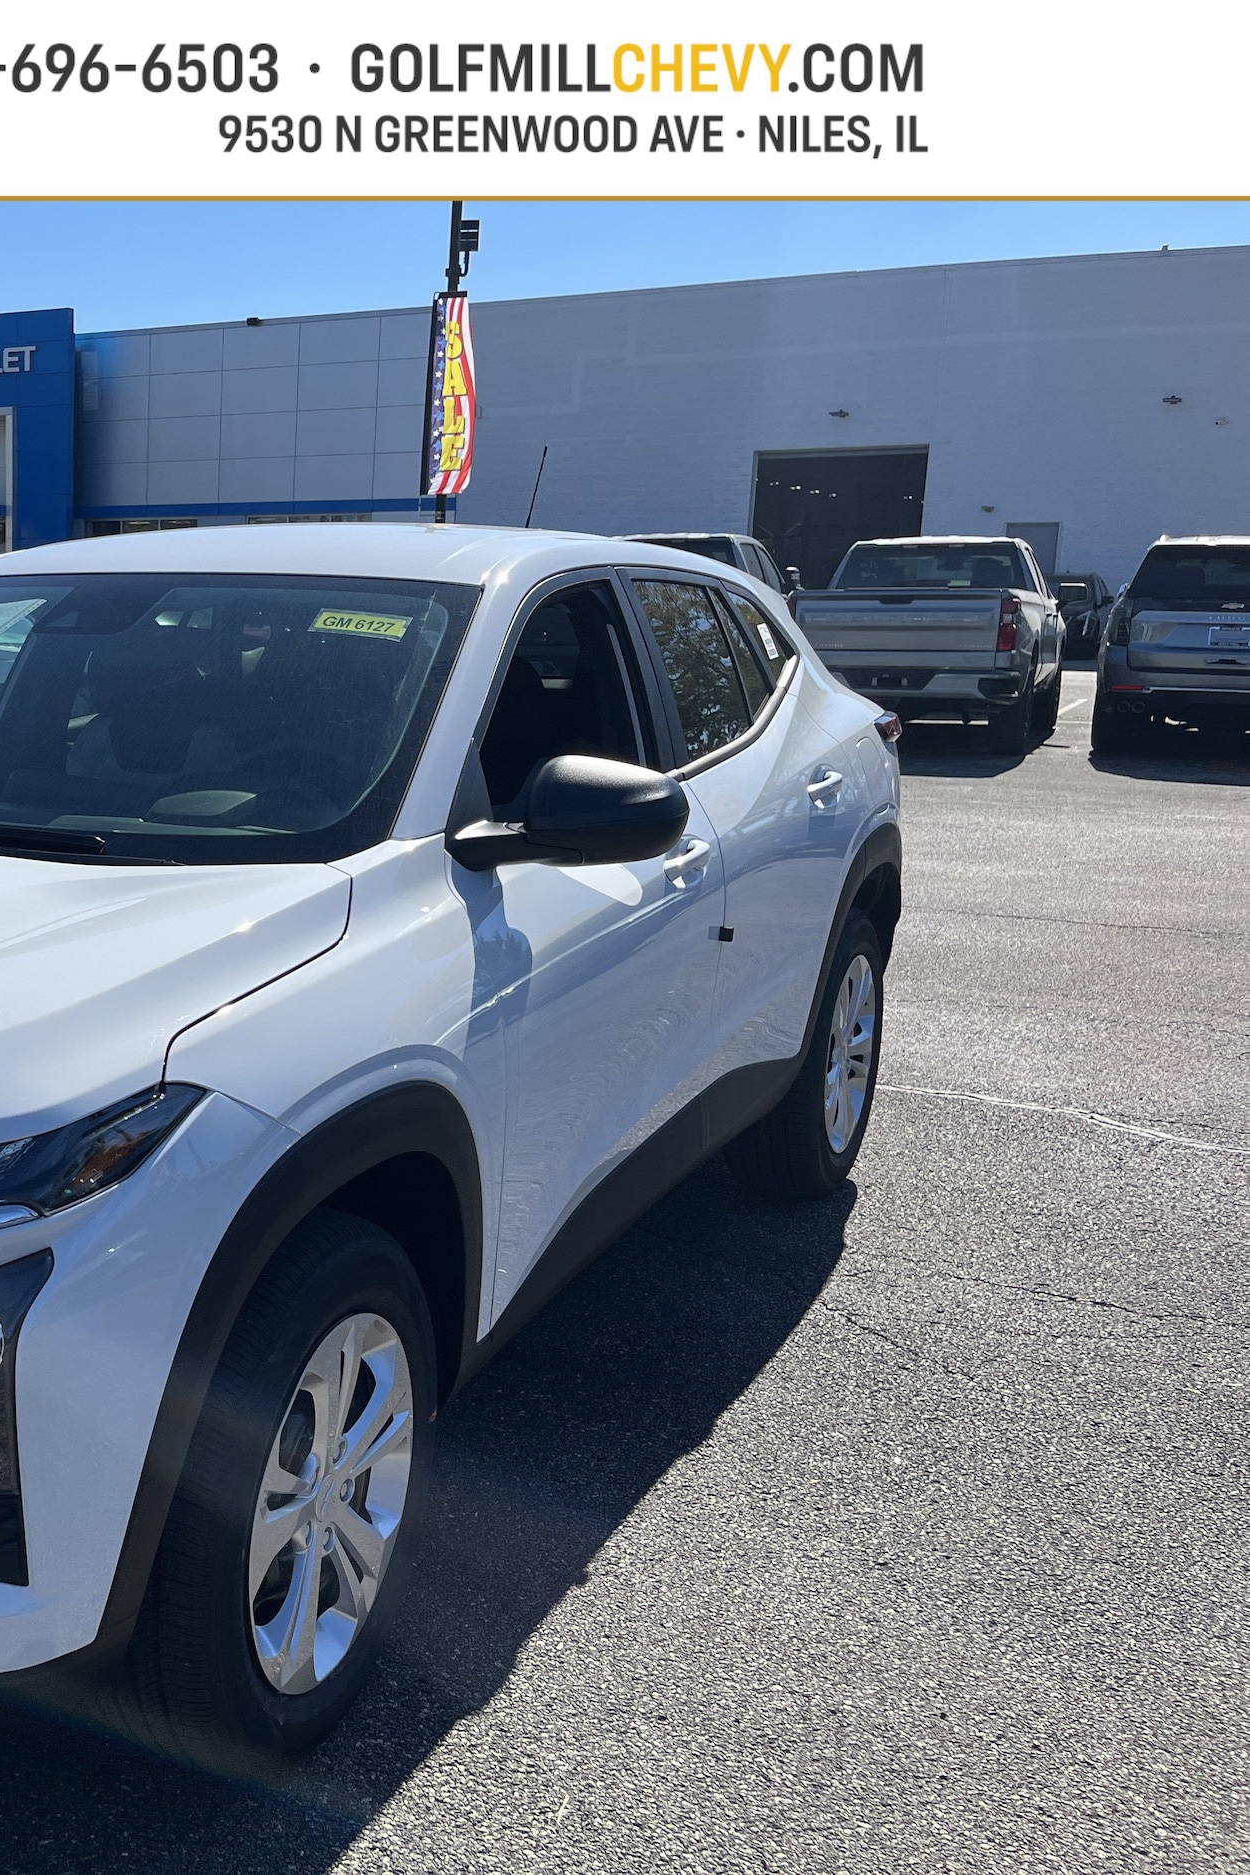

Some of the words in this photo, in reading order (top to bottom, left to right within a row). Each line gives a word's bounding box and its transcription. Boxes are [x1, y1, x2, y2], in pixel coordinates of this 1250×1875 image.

[439, 321, 467, 471] SALE
[322, 616, 352, 629] GM
[354, 620, 395, 633] 6127
